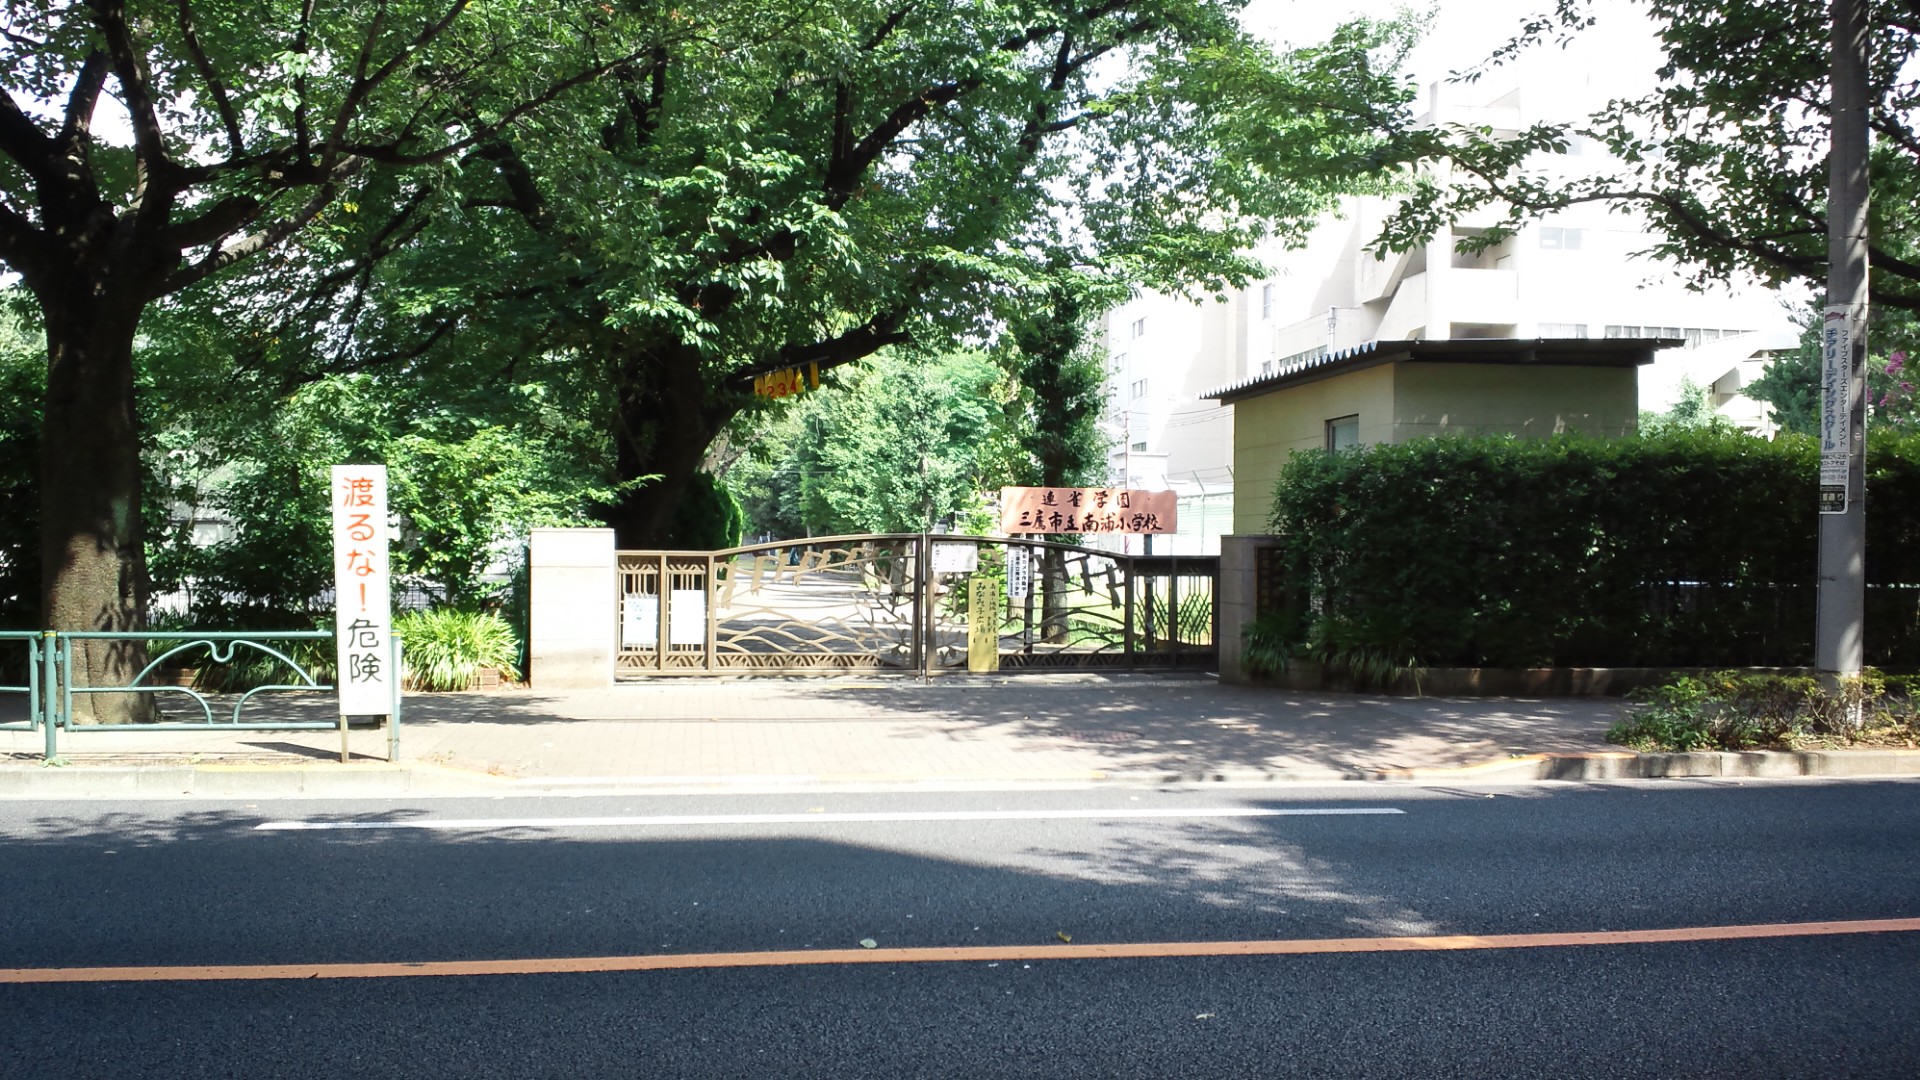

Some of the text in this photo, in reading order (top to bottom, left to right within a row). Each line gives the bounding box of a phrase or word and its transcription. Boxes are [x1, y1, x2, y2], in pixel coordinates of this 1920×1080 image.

[766, 385, 775, 399] 2
[778, 383, 787, 397] 3
[1041, 490, 1130, 508] 連雀学園
[1019, 509, 1163, 533] 三鷹市立南浦小学校
